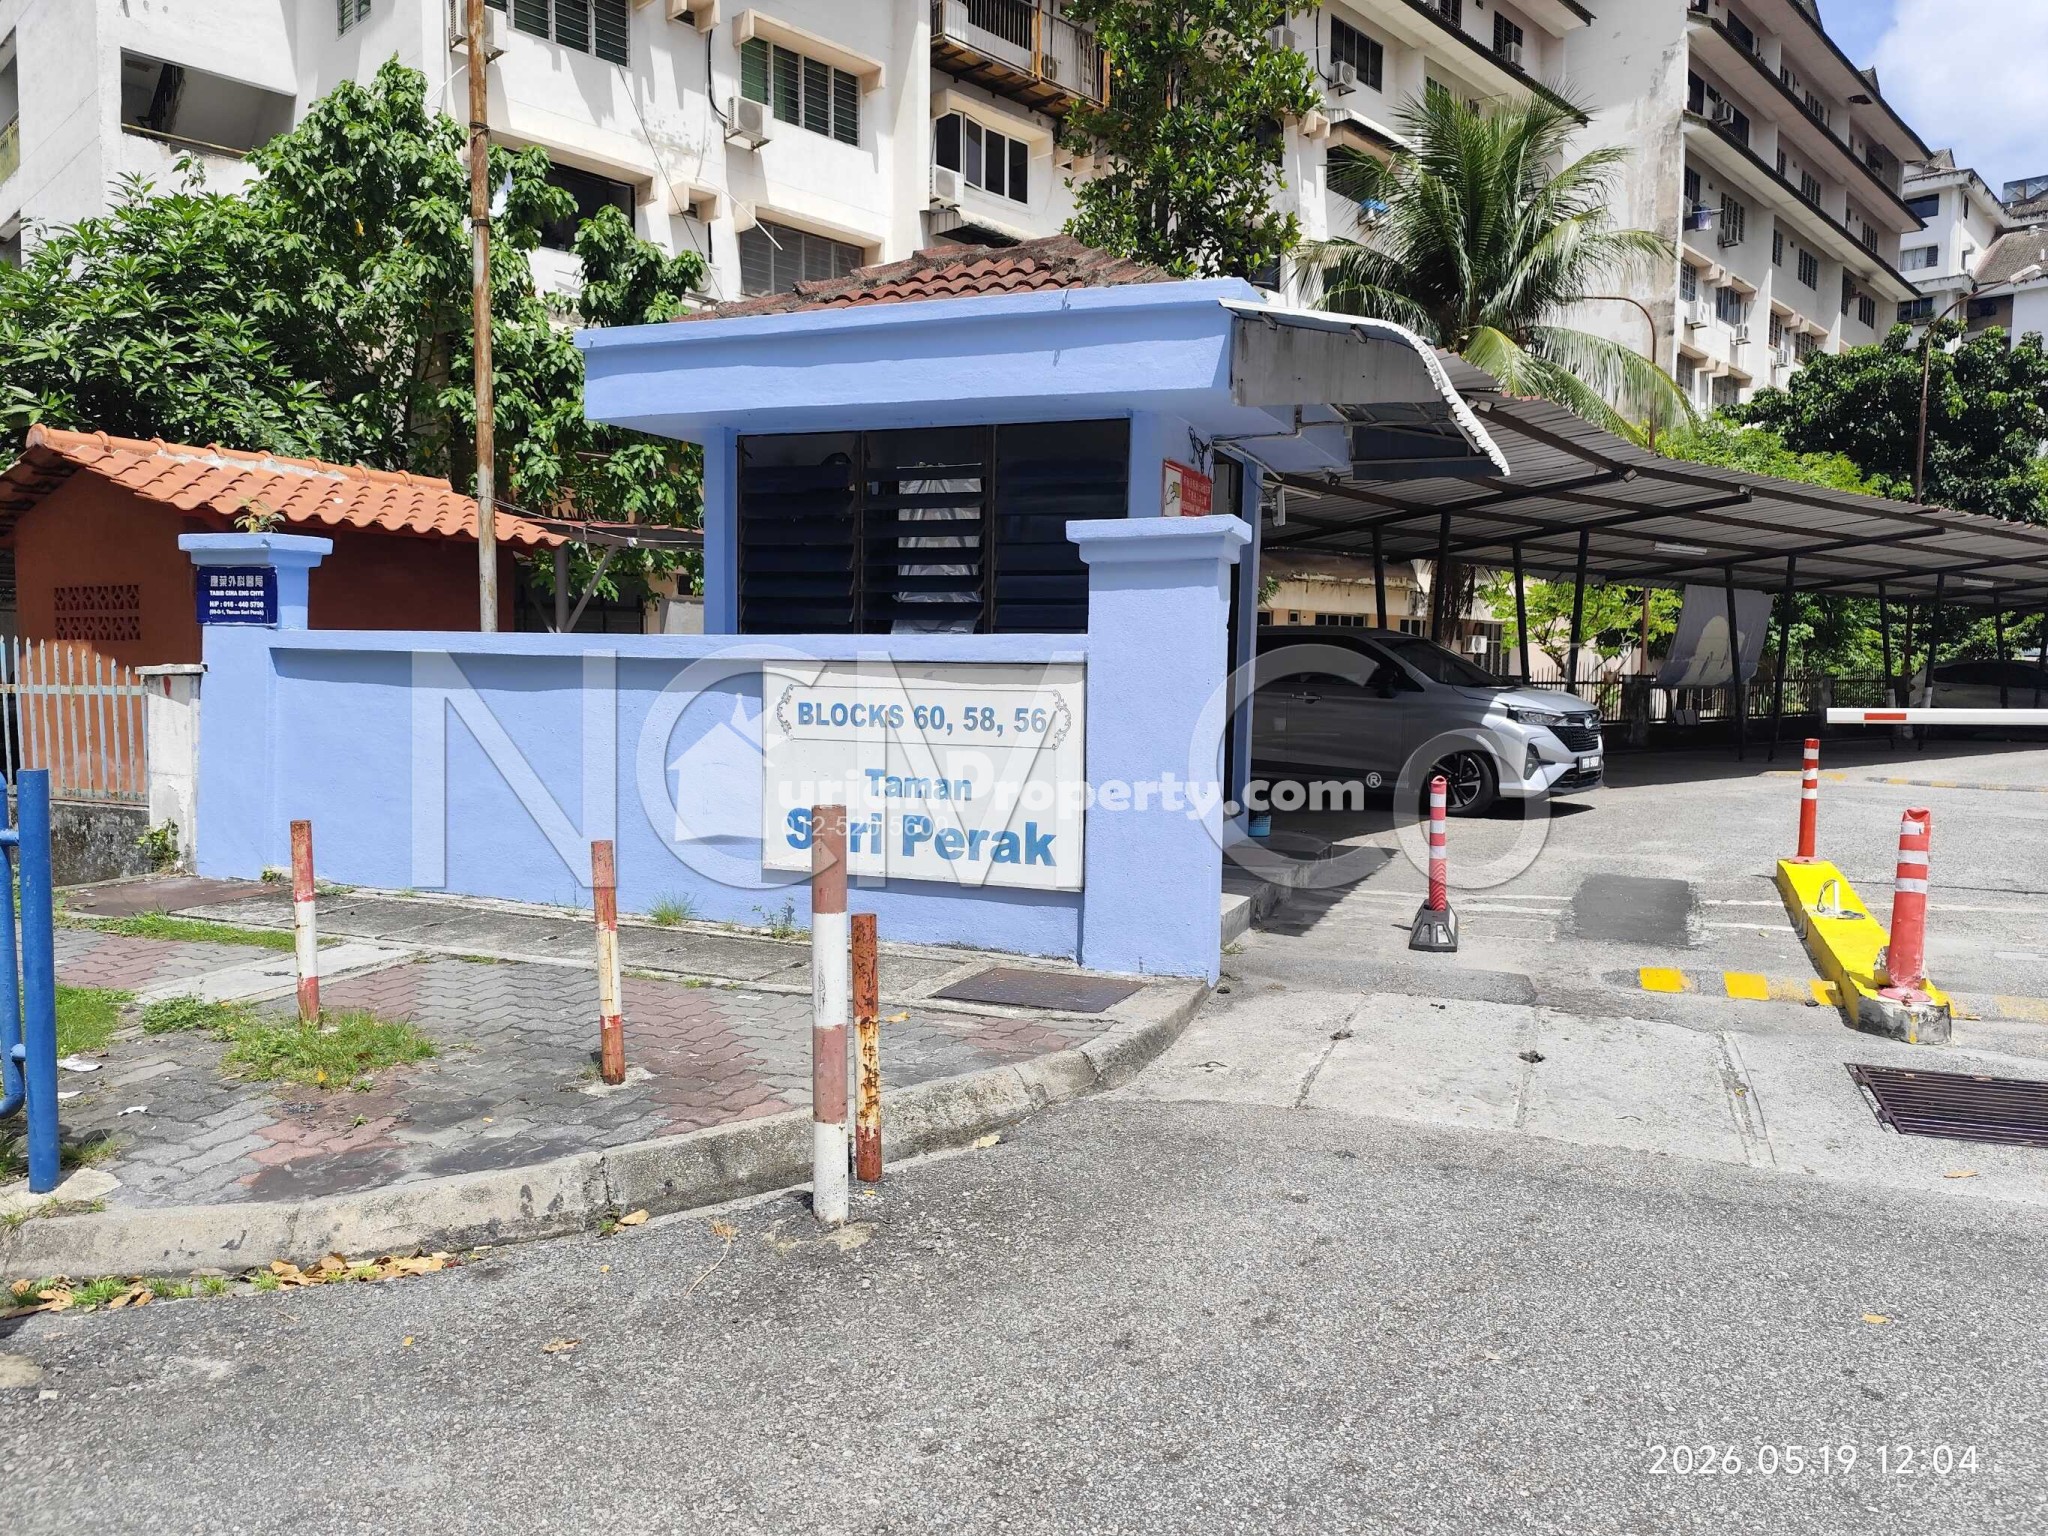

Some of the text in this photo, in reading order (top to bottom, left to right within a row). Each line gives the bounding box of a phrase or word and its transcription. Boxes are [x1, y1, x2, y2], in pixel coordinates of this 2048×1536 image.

[798, 702, 1048, 737] BLOCKS 60, 58, 56
[865, 768, 973, 801] Taman
[786, 807, 1058, 867] Sri Perak
